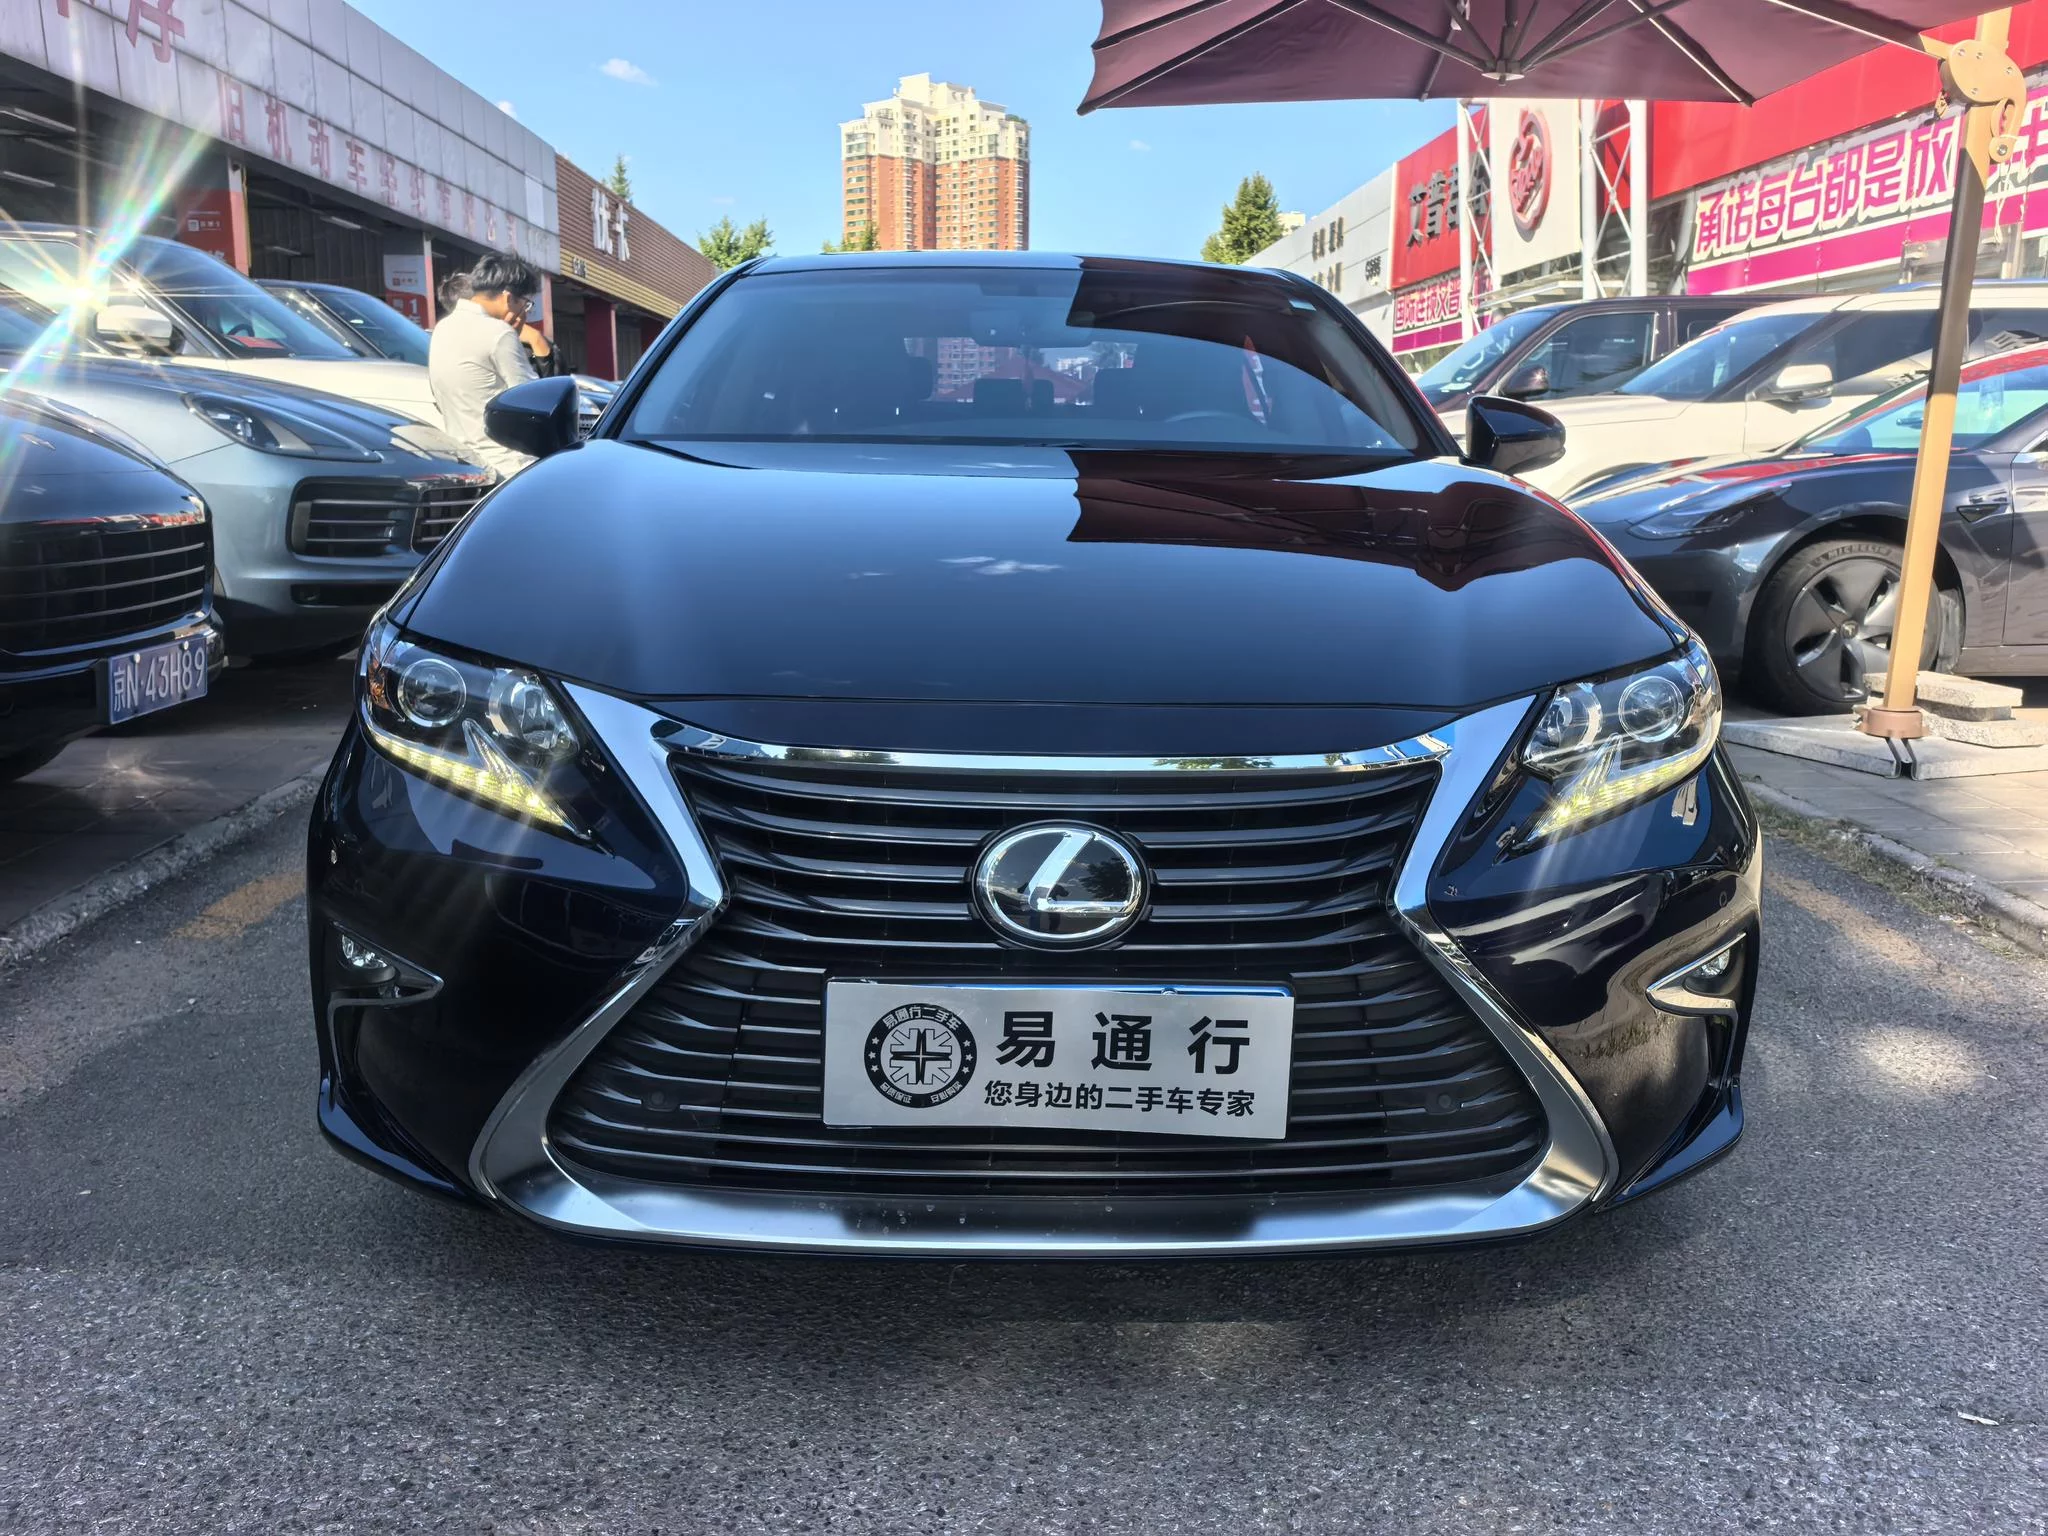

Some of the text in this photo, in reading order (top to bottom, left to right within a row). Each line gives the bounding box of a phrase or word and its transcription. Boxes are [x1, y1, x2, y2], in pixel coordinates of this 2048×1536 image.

[113, 647, 205, 712] 京N·43H89
[883, 1006, 962, 1030] 易通行二手车
[995, 1011, 1250, 1075] 易通行
[984, 1080, 1255, 1117] 您身边的二手车专家
